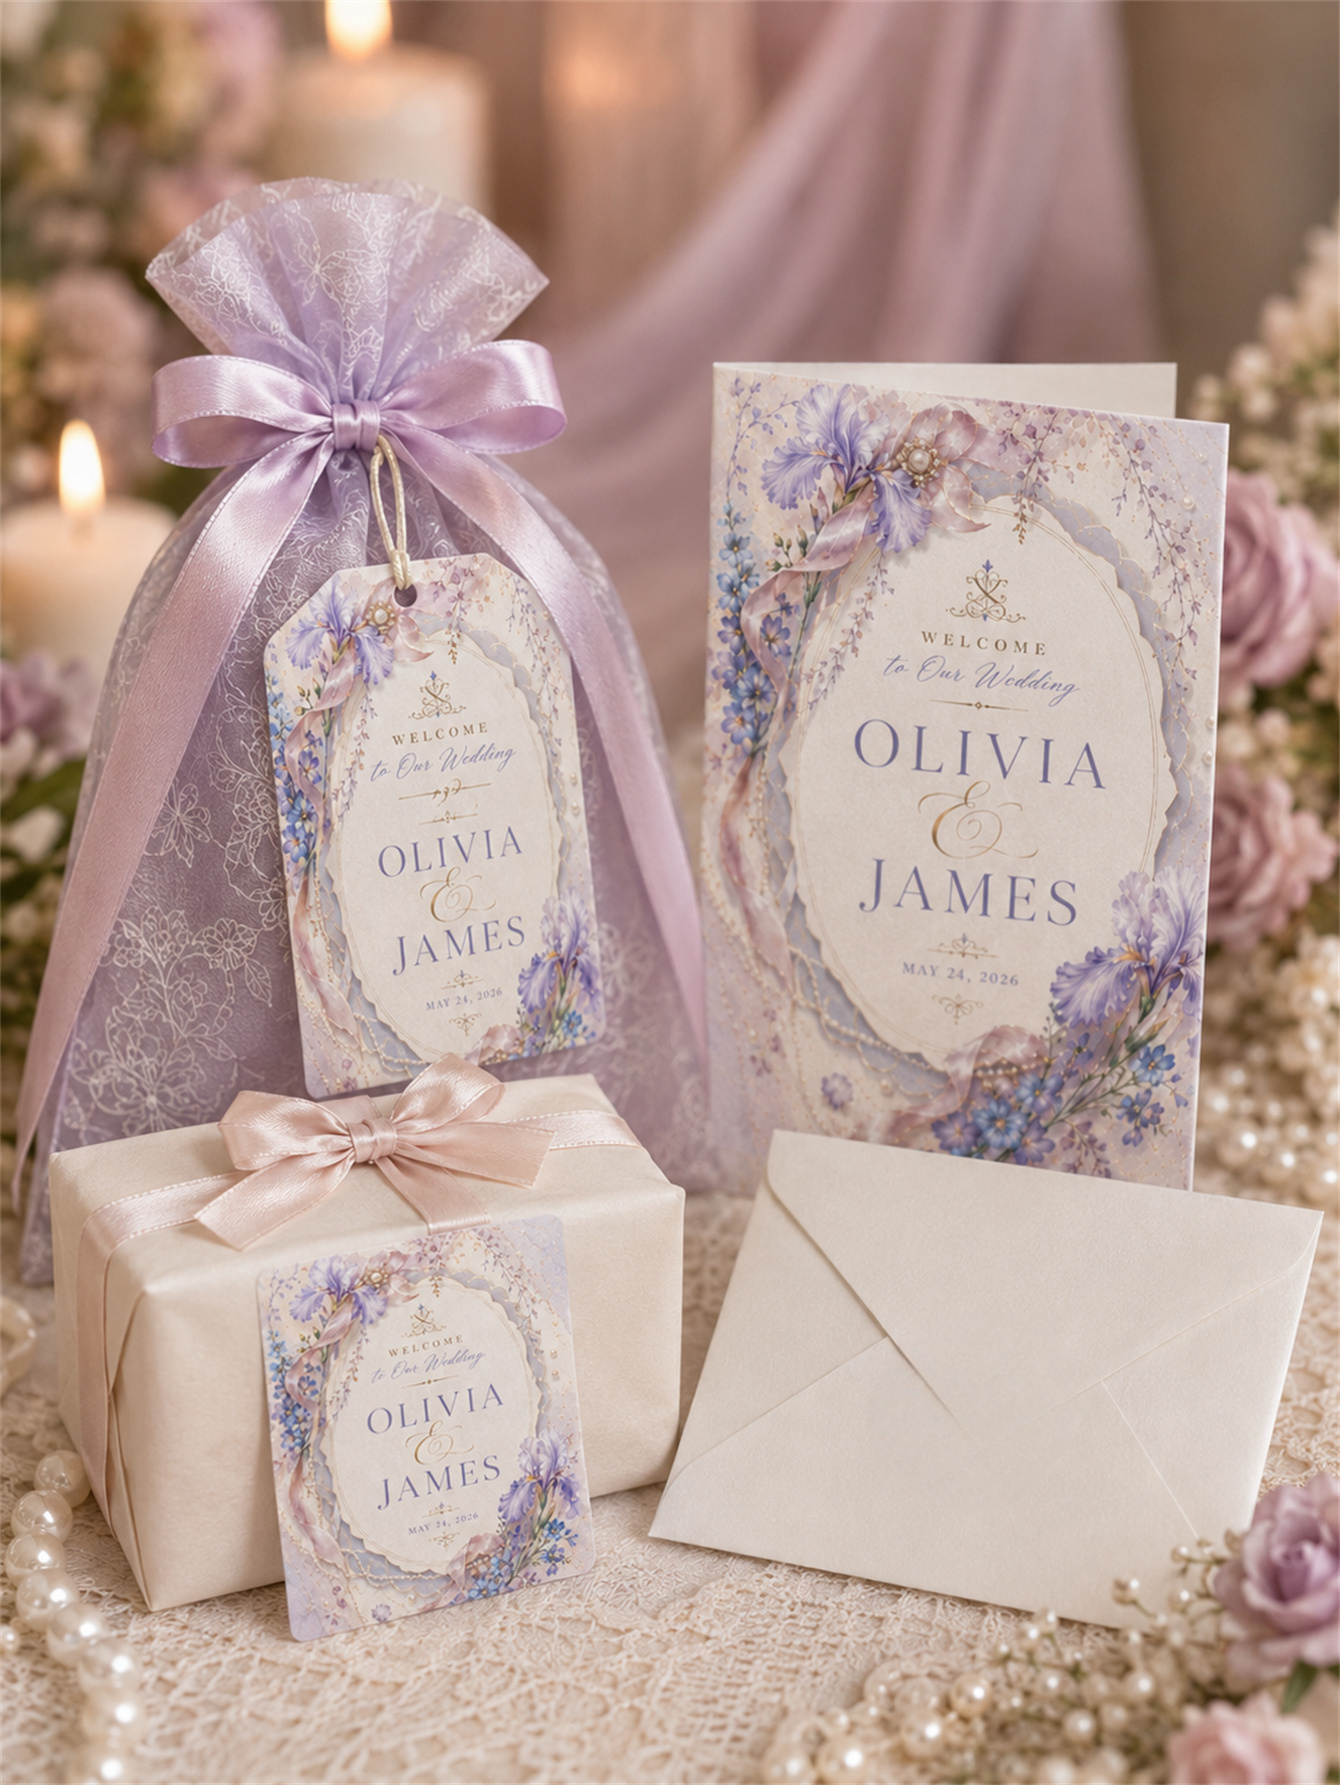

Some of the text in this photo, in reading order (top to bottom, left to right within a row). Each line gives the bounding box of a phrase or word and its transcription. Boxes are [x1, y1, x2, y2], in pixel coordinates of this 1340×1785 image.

[921, 630, 1046, 656] WELCOME
[882, 655, 1081, 708] to Our Wedding
[392, 721, 488, 746] WELCOME
[370, 742, 516, 782] to Our Wedding
[854, 718, 1106, 790] OLIVIA
[378, 826, 523, 878] OLIVIA
[858, 858, 1077, 926] JAMES
[392, 915, 525, 976] JAMES
[902, 962, 1019, 987] MAY 24, 2026
[426, 987, 503, 1011] MAY 24, 2026
[388, 1334, 464, 1358] WELCOME
[371, 1368, 386, 1384] to
[423, 1349, 486, 1372] Wedding
[367, 1383, 503, 1434] OLIVIA
[377, 1455, 500, 1510] JAMES
[408, 1522, 430, 1535] MAY
